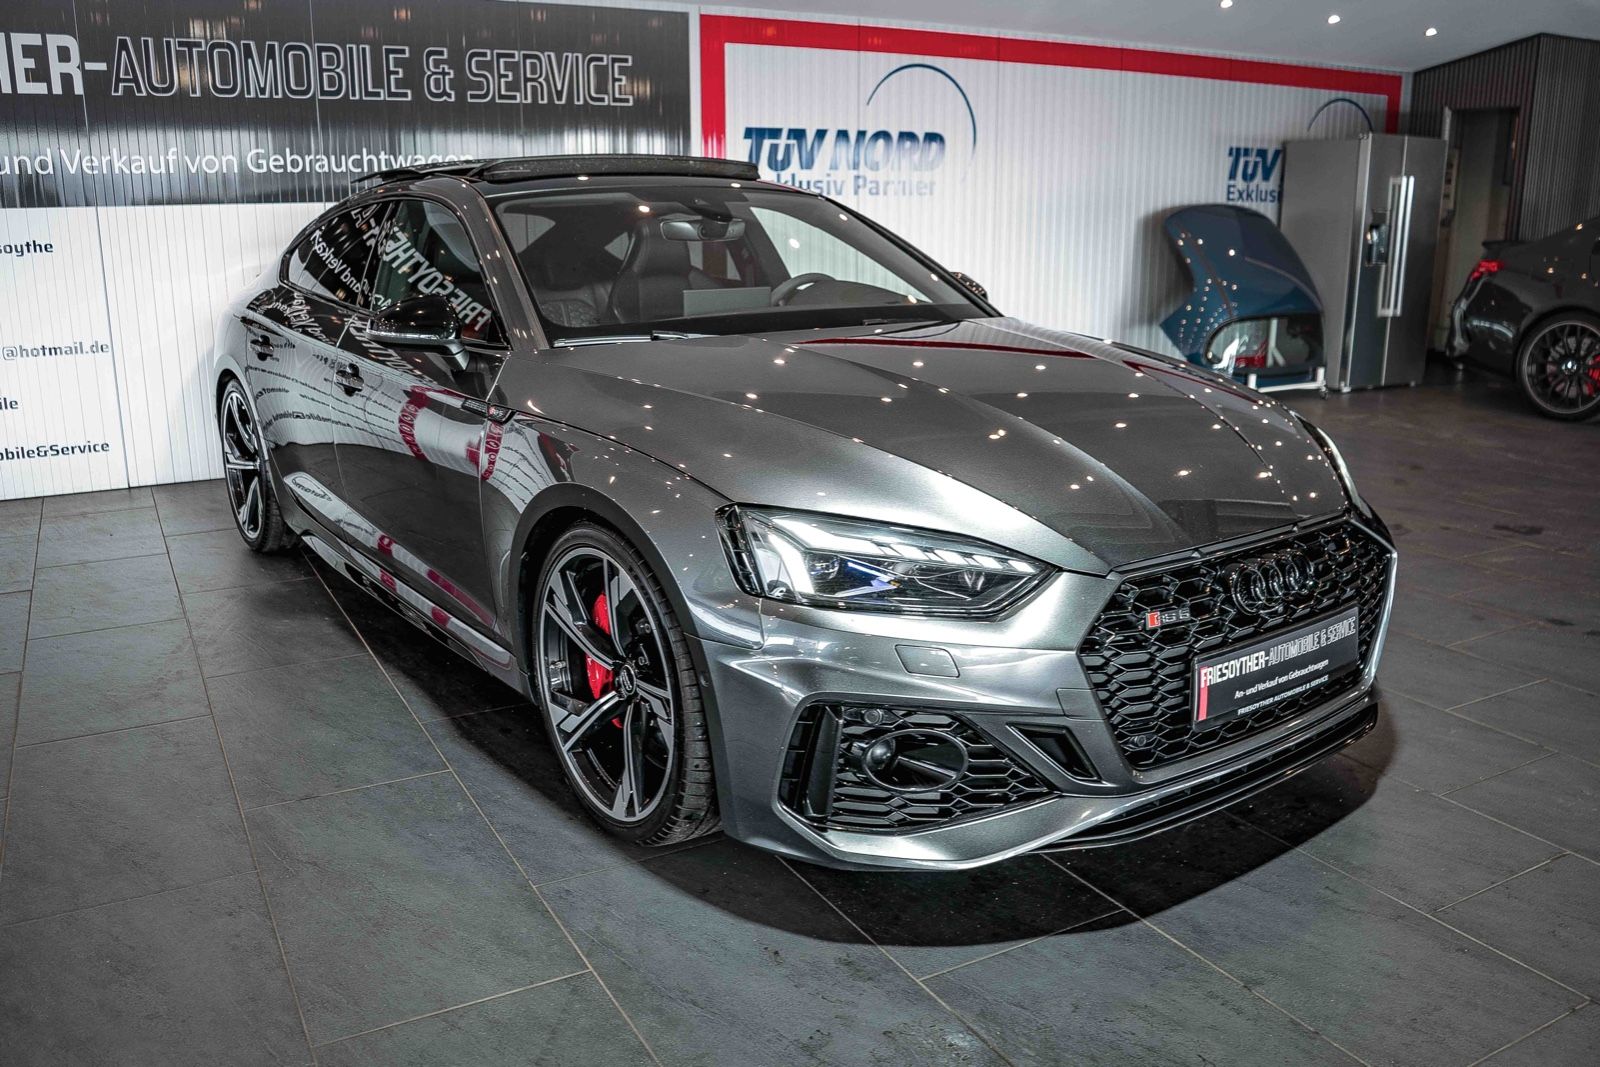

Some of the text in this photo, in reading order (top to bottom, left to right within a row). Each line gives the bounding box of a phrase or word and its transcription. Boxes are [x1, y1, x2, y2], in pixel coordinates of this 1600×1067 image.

[423, 47, 455, 101] &
[465, 49, 633, 106] SERVICE
[59, 147, 177, 175] Verkauf
[184, 153, 238, 174] von
[829, 129, 946, 172] NORD
[1200, 631, 1320, 689] FRIESOYTHER-AUTOMOBILE
[1327, 616, 1356, 645] SERVICE
